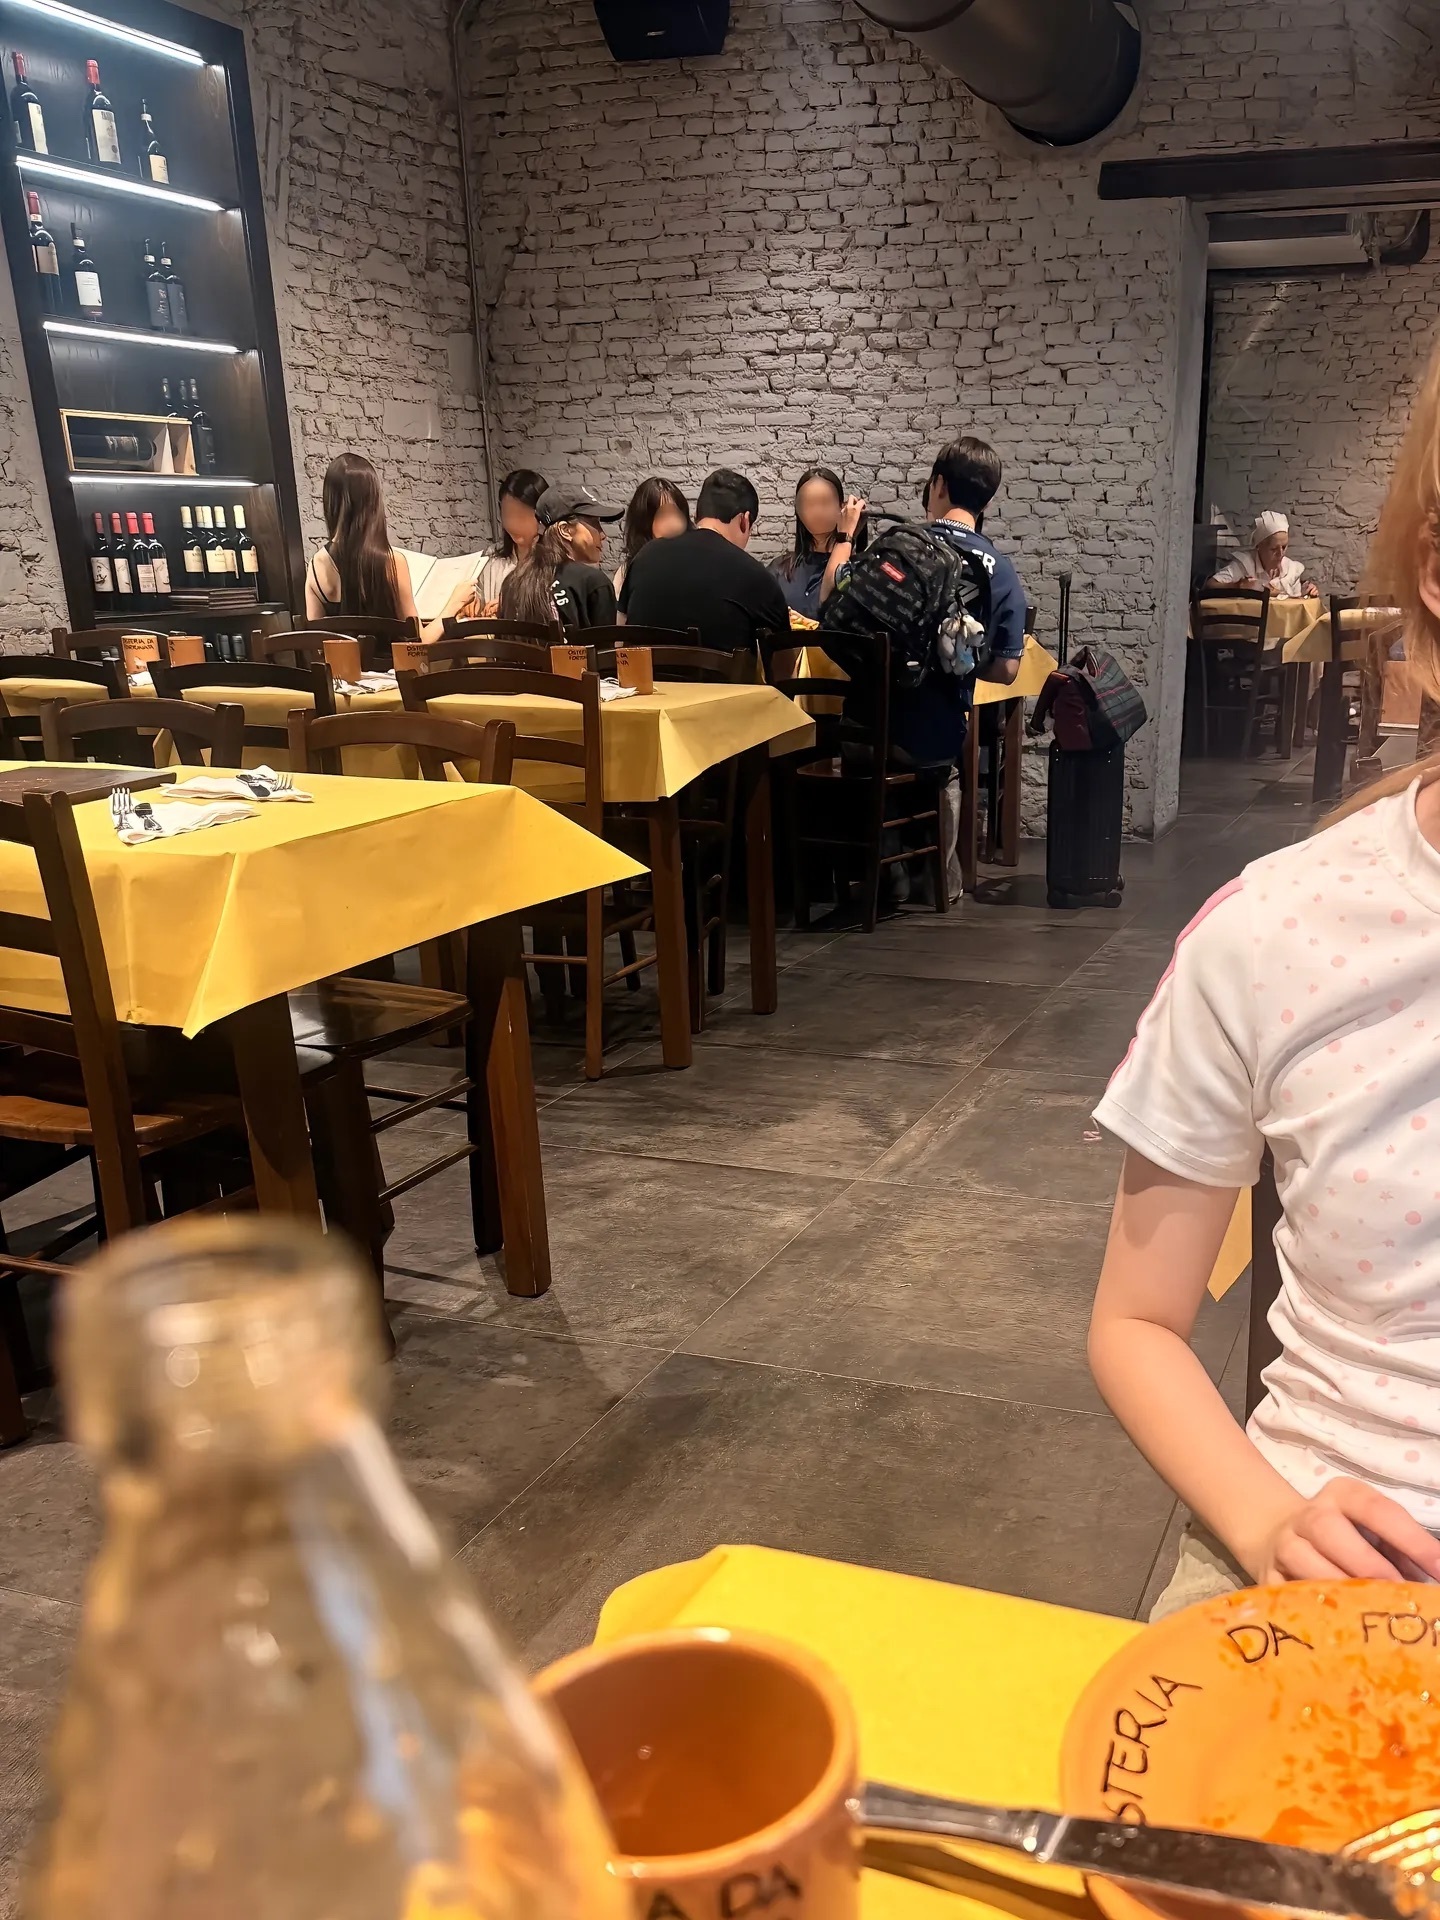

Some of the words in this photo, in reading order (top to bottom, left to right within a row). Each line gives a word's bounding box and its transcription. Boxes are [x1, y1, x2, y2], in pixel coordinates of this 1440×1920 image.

[553, 589, 570, 606] 26
[1101, 1674, 1204, 1826] STERIA
[1227, 1620, 1315, 1664] DA
